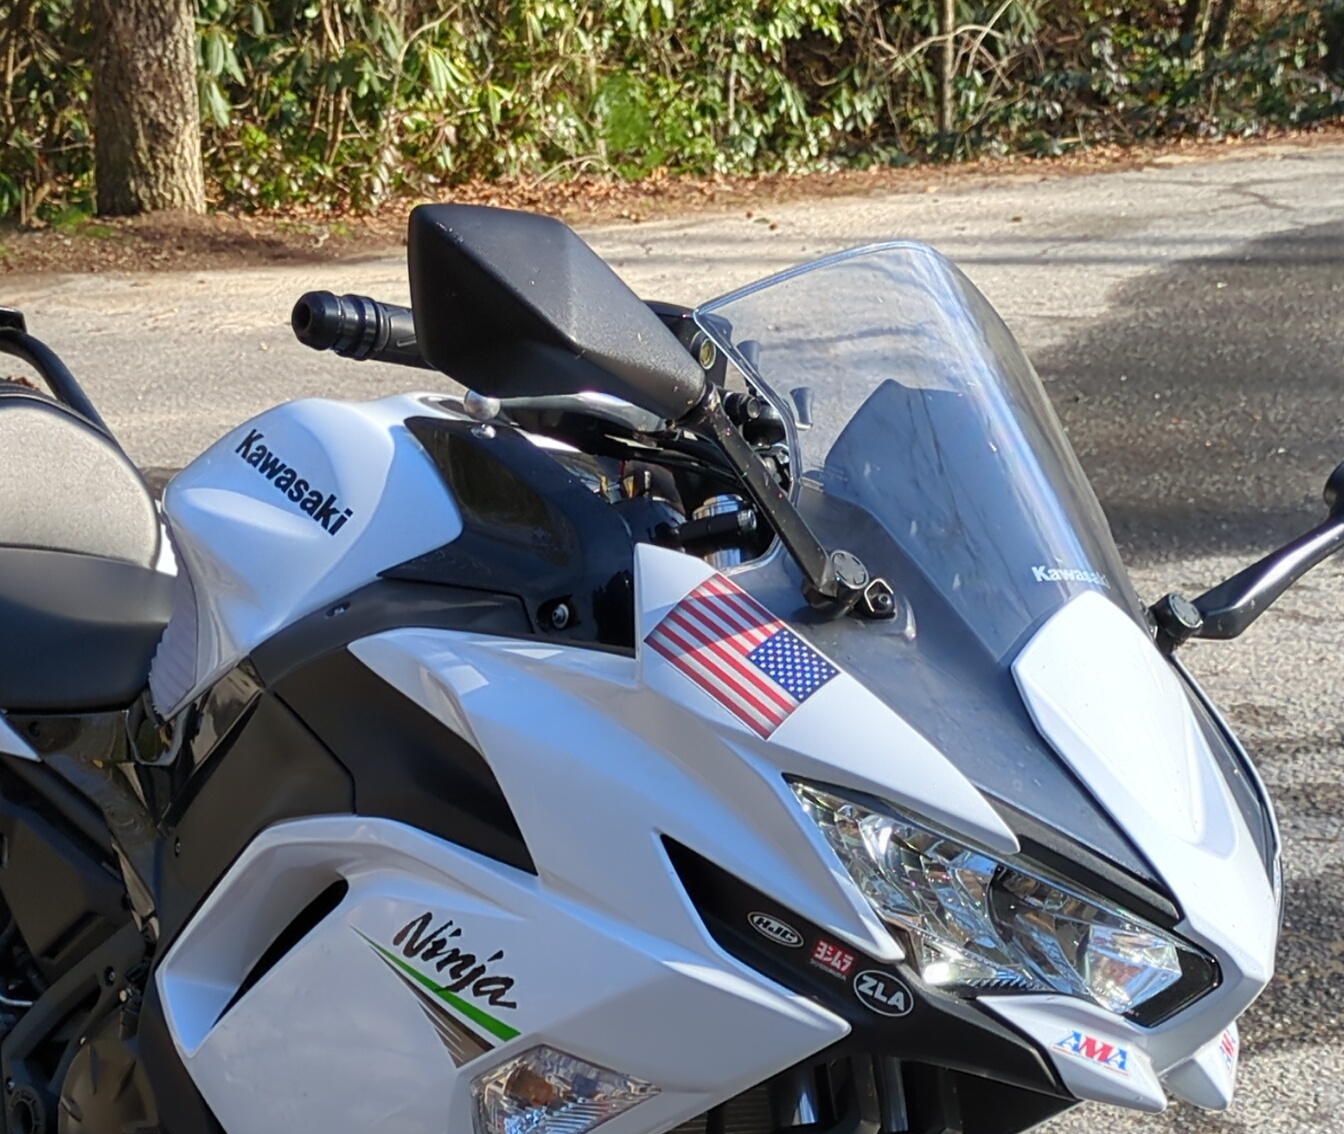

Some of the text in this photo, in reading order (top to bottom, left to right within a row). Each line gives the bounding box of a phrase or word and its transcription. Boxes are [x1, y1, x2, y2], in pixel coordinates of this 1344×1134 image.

[234, 428, 354, 536] Kawasaki
[755, 917, 797, 943] HJC
[392, 911, 517, 1010] Ninja
[857, 974, 905, 1012] ZLA
[1056, 1030, 1127, 1071] AMA
